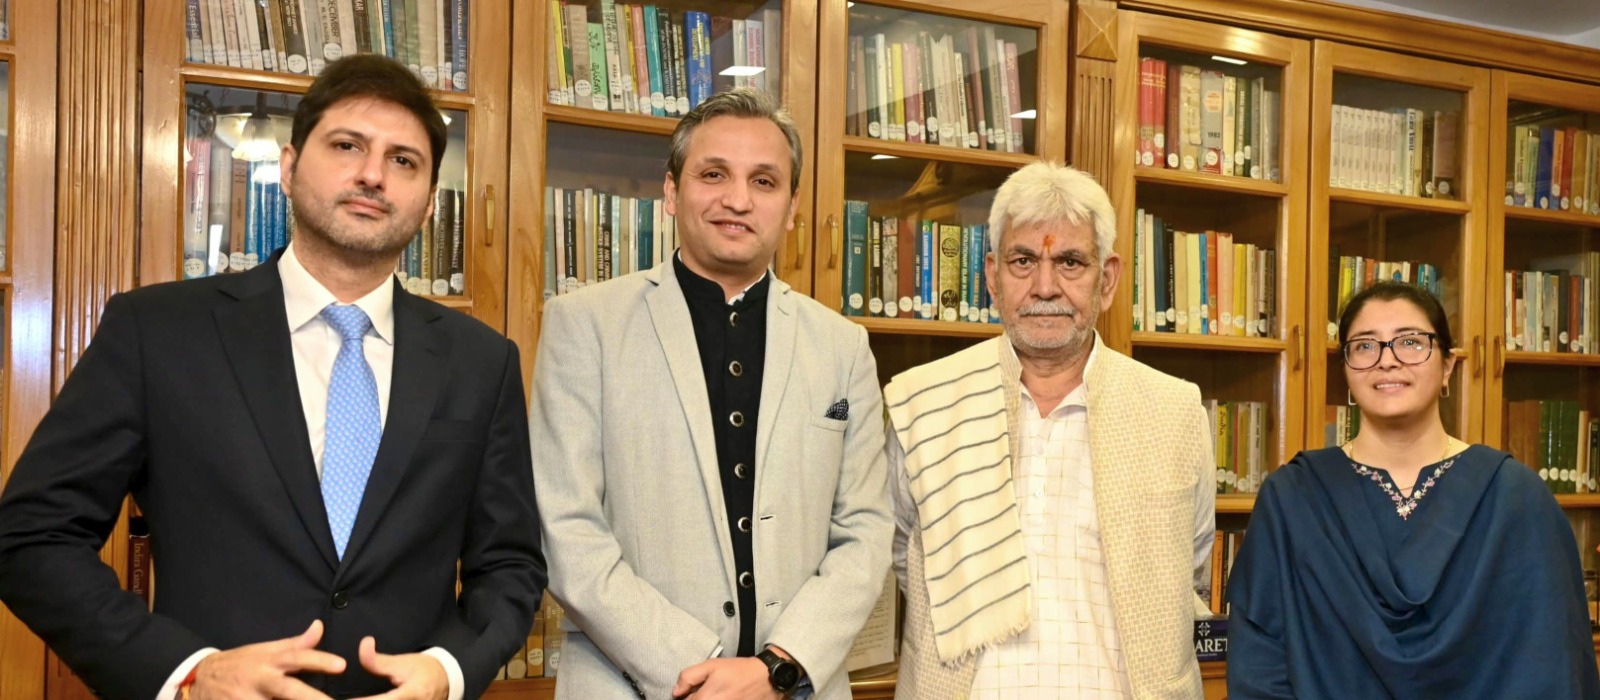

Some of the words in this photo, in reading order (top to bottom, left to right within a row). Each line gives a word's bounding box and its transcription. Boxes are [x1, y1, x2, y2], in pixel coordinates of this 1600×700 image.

[188, 5, 201, 38] Essential
[328, 0, 340, 38] DECEMBER
[134, 542, 144, 568] Indira
